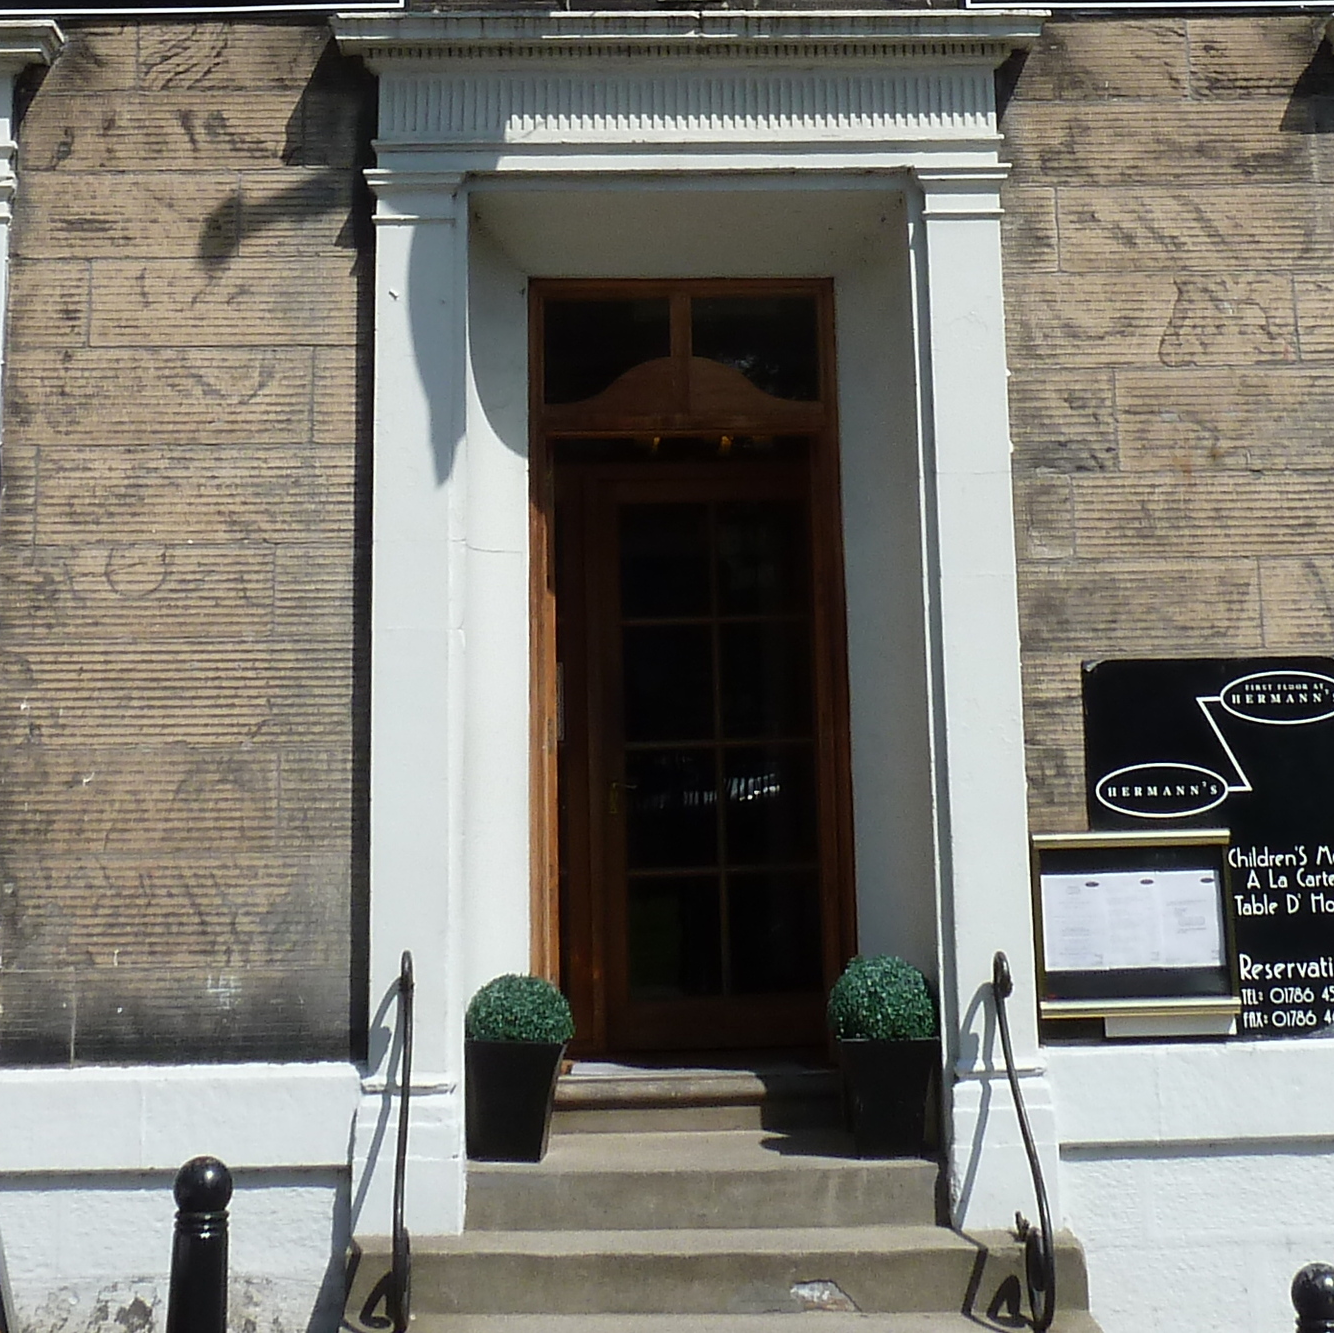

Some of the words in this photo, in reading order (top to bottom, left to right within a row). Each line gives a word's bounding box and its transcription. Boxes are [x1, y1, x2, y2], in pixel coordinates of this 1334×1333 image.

[1107, 780, 1218, 798] HERMANN'S
[1246, 868, 1261, 889] A
[1268, 868, 1288, 889] La
[1233, 893, 1279, 916] Table
[1241, 988, 1264, 1006] TEL:
[1269, 986, 1315, 1004] 01786
[1271, 1009, 1317, 1027] 01786
